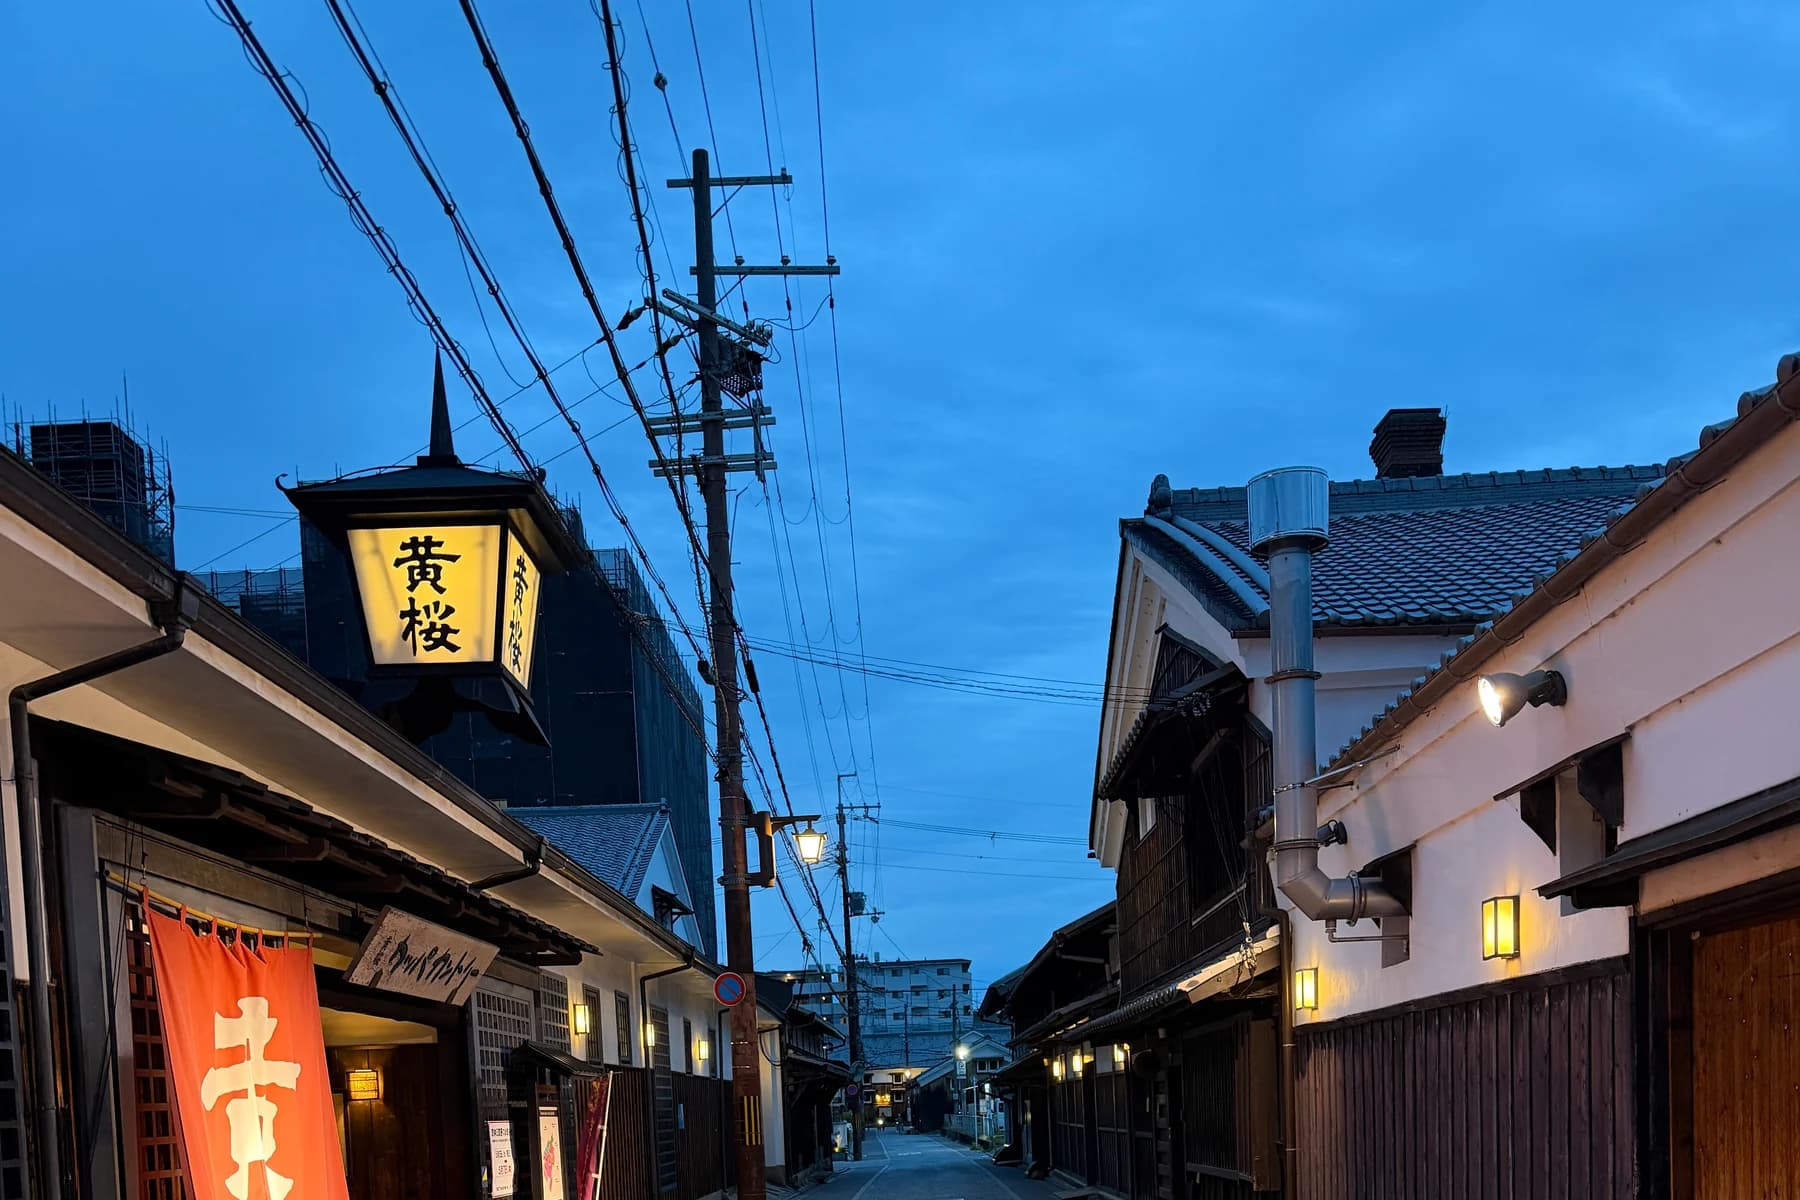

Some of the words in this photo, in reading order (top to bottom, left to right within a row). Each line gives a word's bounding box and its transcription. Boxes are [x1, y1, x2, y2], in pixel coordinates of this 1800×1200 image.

[393, 535, 462, 657] 黄桜
[509, 554, 528, 673] 黄桜
[388, 933, 480, 988] カッパカントリー
